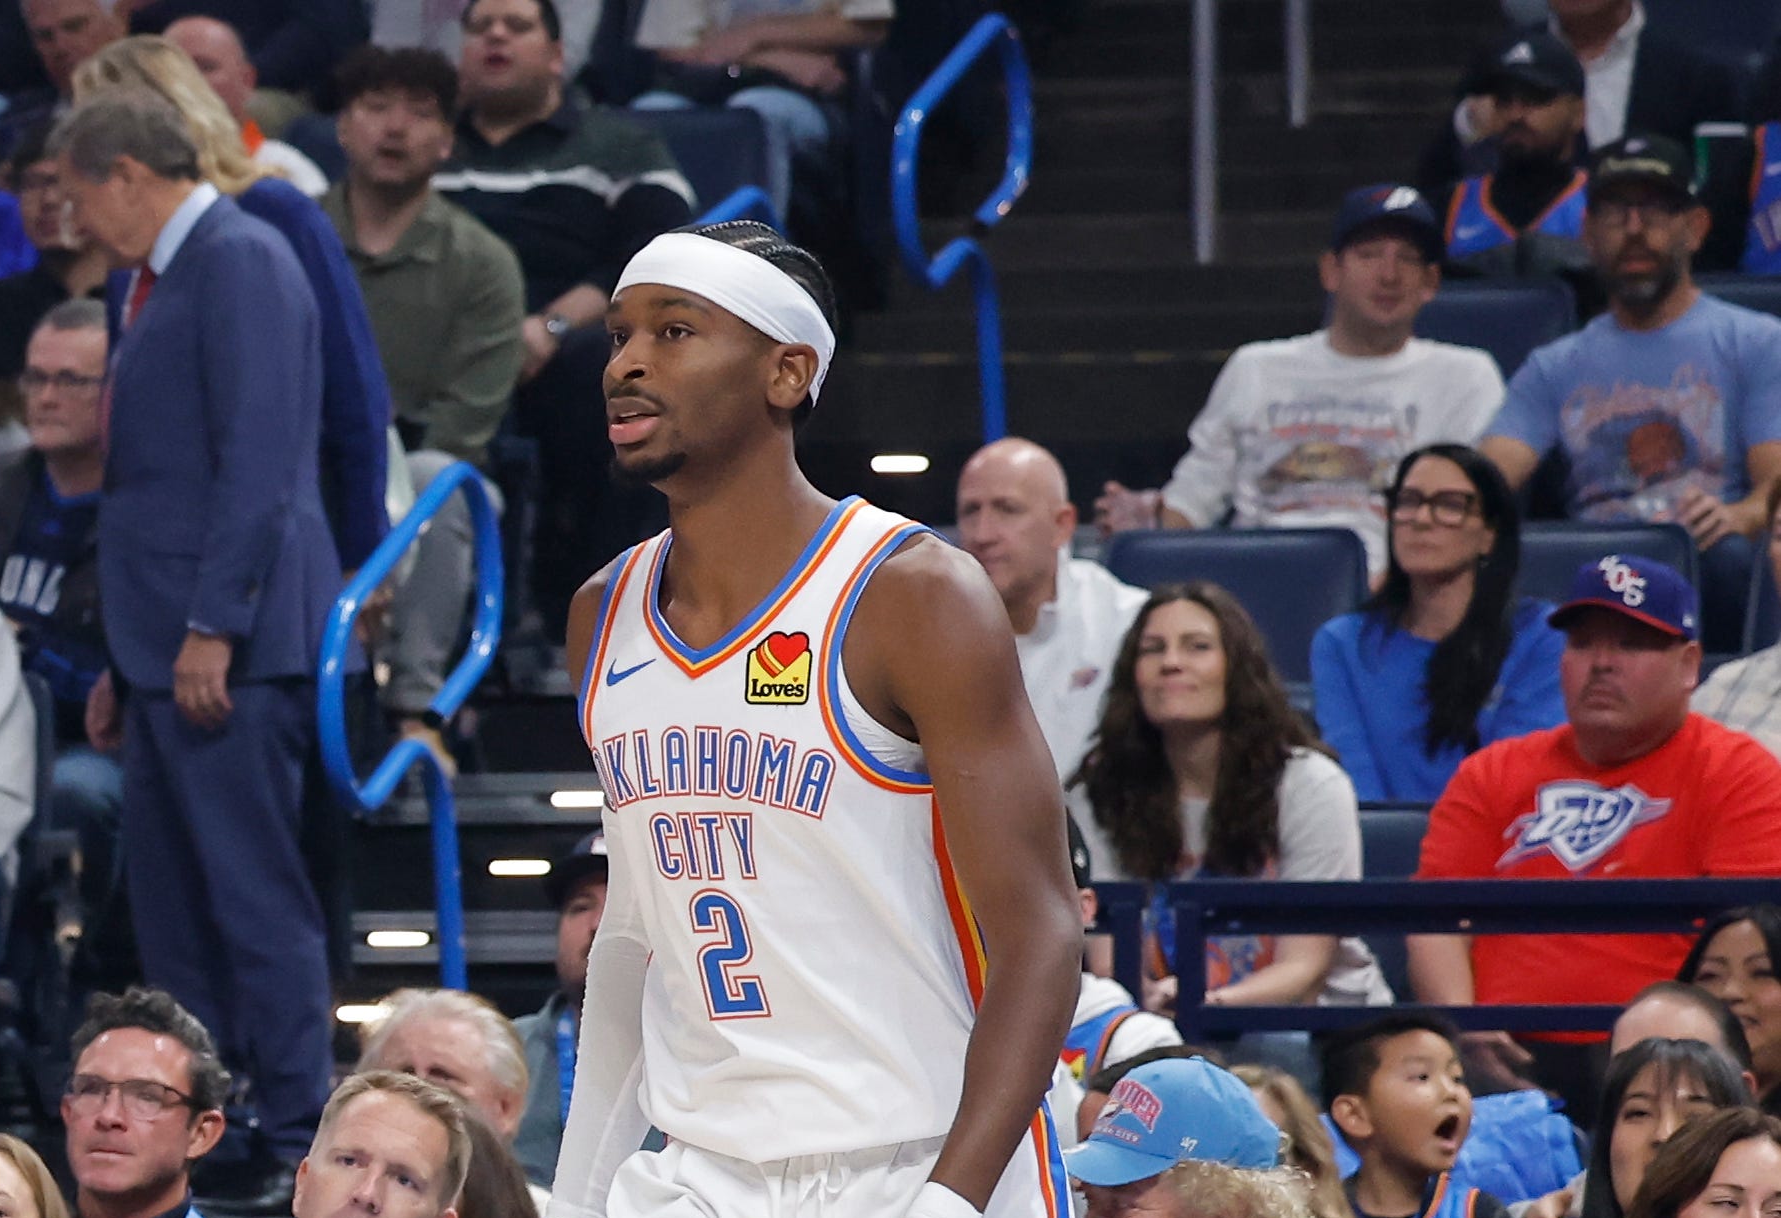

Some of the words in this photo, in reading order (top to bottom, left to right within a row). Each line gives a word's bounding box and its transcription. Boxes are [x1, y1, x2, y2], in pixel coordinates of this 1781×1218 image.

[592, 725, 837, 820] OKLAHOMA
[649, 811, 757, 880] CITY
[689, 888, 771, 1021] 2
